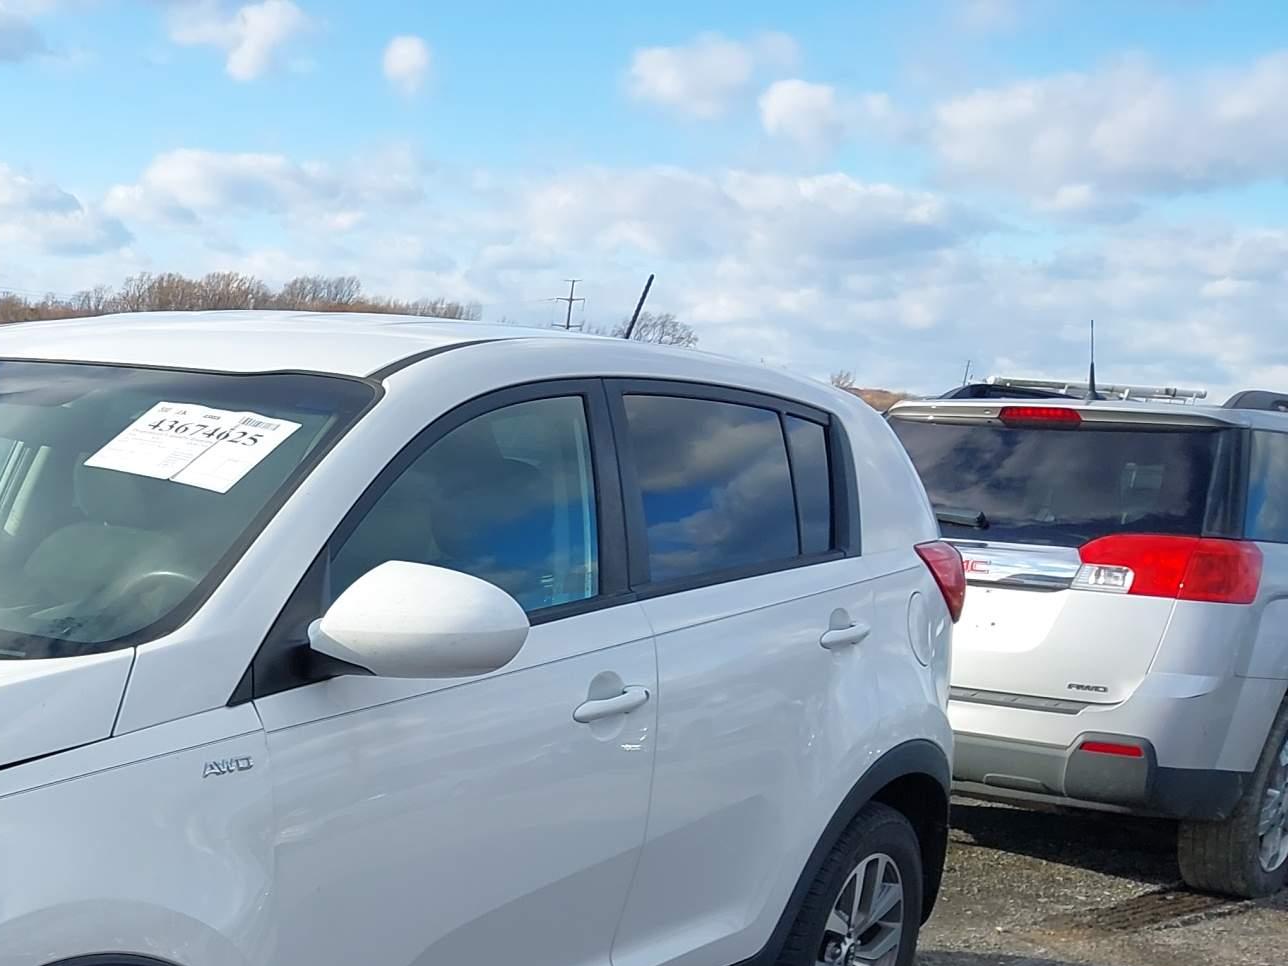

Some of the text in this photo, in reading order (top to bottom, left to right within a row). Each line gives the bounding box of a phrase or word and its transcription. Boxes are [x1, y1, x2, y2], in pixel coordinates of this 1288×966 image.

[148, 418, 264, 447] 43674625
[1066, 683, 1109, 693] AWD
[203, 756, 254, 778] AWD
